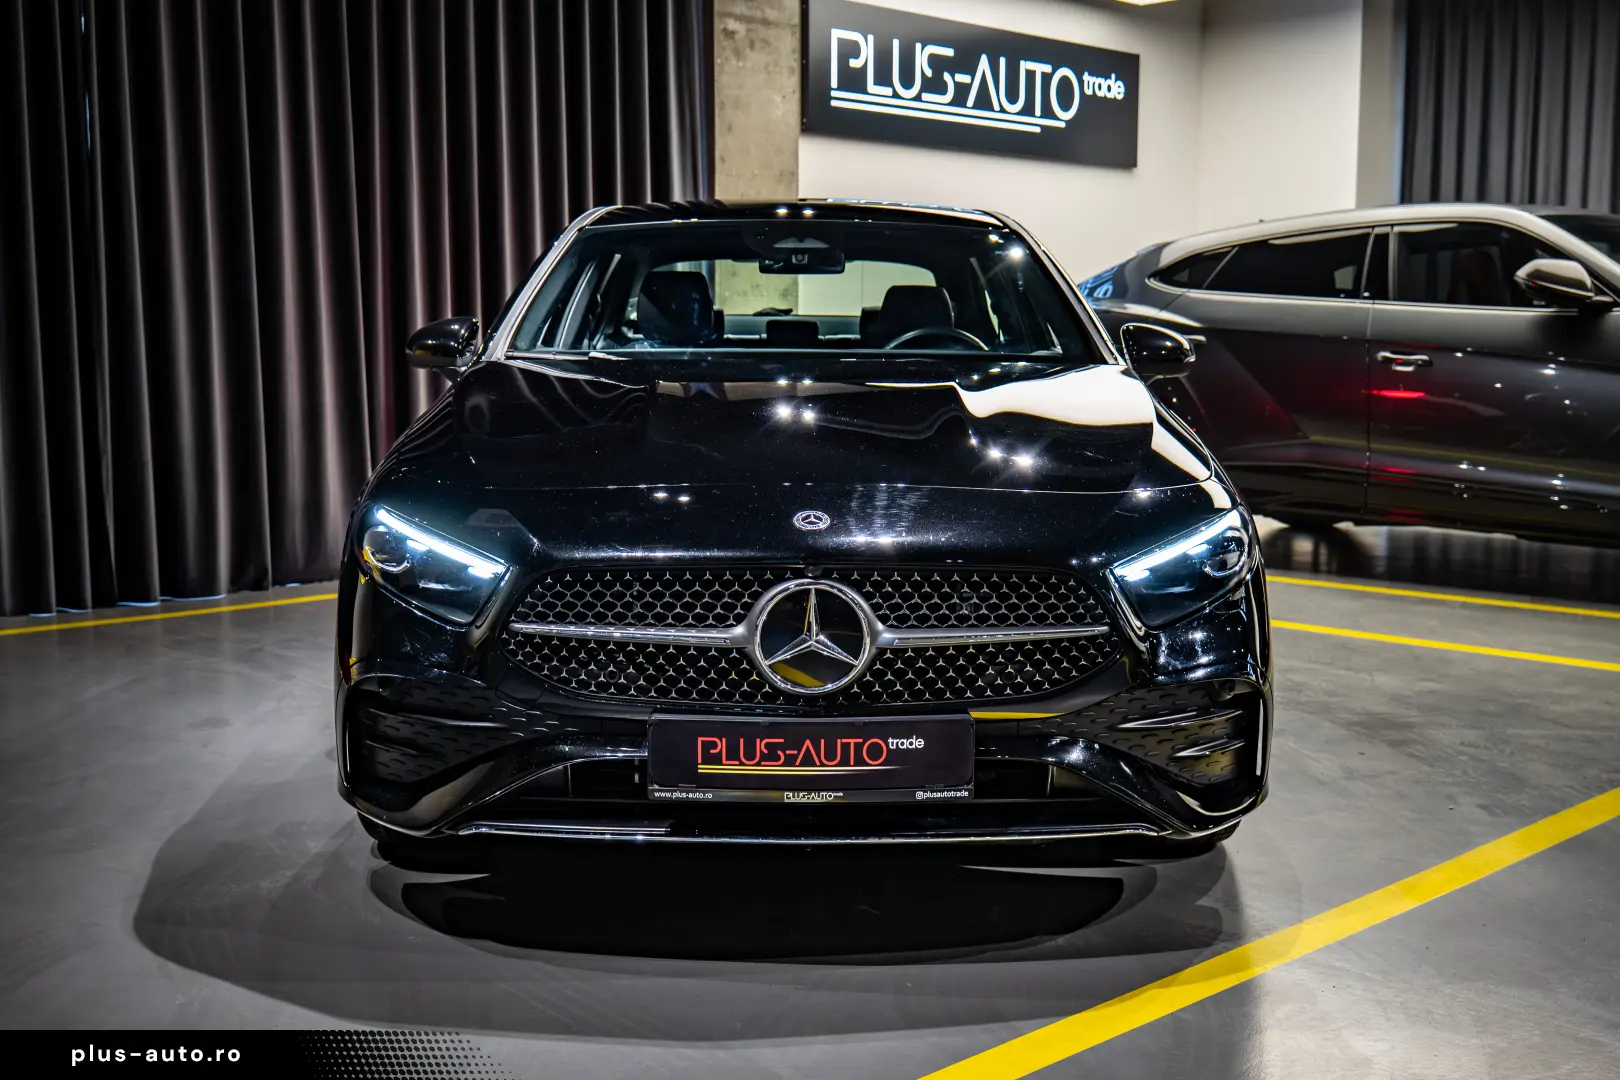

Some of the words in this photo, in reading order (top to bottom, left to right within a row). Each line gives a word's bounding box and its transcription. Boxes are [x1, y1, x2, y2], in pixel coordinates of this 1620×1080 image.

[830, 28, 1080, 121] PLUS-AUTO
[1082, 72, 1125, 100] trade
[698, 737, 887, 766] PLUS-AUTO
[888, 735, 925, 750] trade
[654, 791, 713, 799] www.plus-auto.ro
